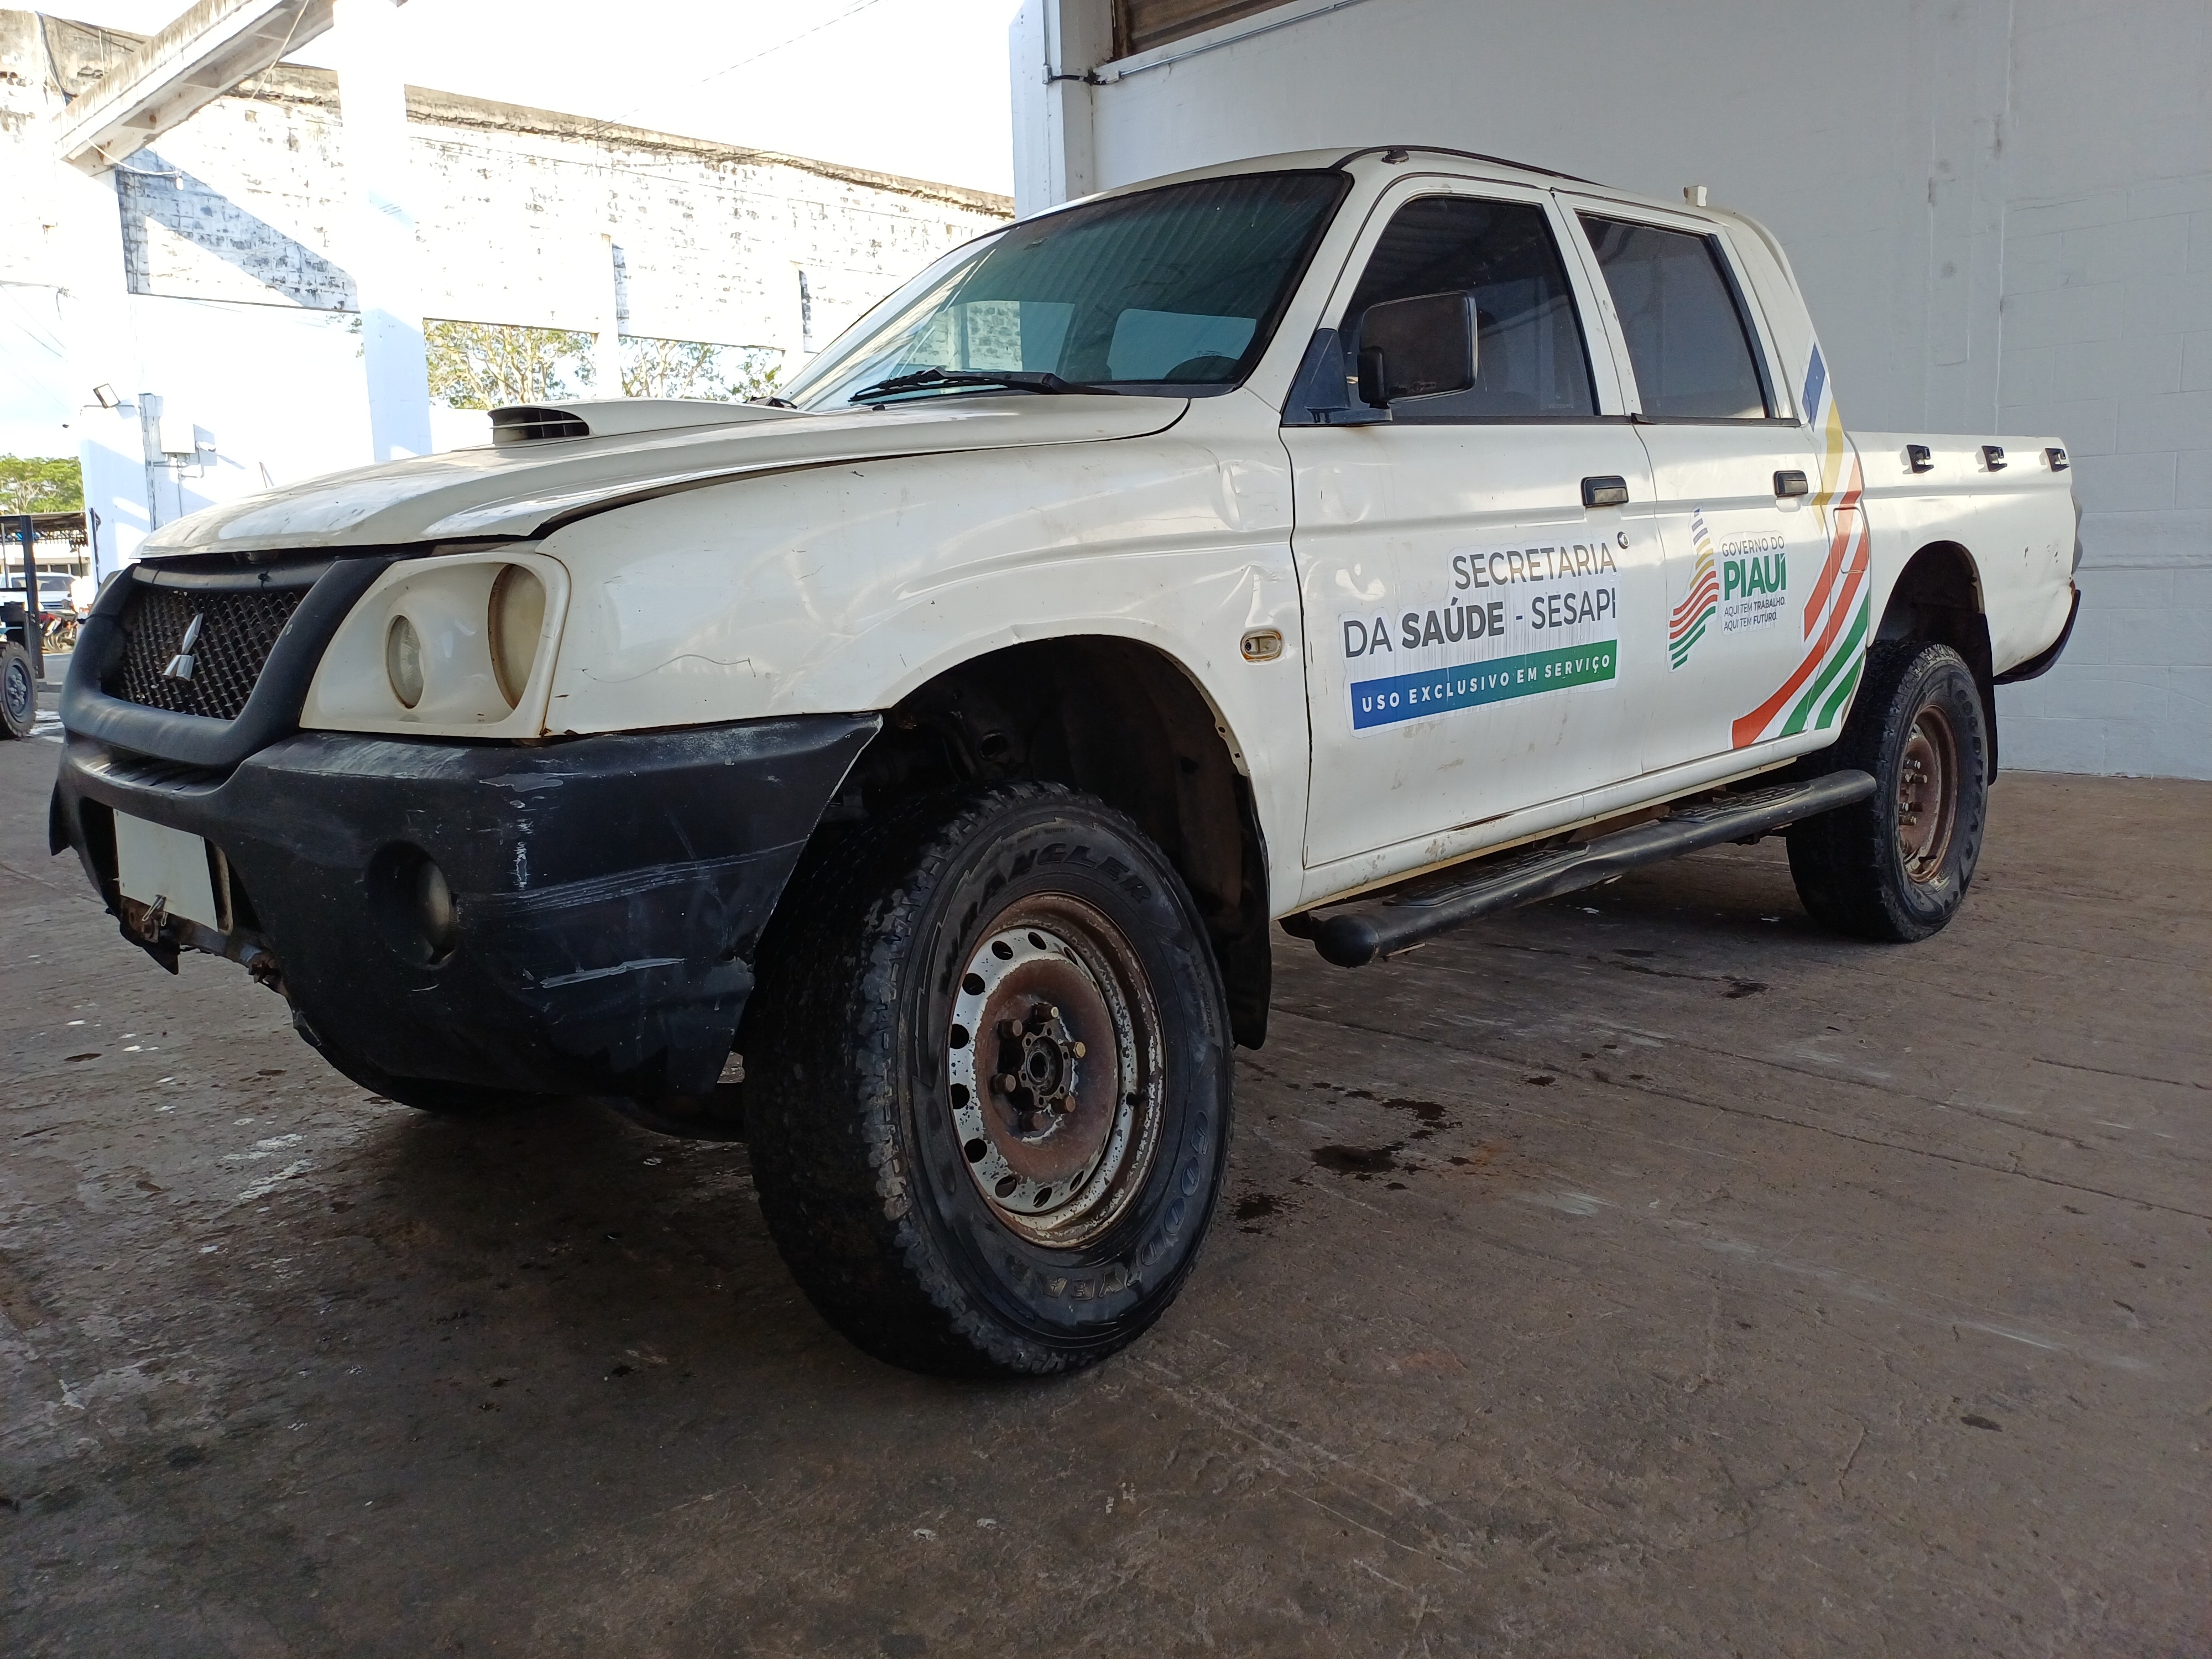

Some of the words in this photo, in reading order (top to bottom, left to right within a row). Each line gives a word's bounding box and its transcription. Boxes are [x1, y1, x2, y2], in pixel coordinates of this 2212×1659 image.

[1453, 543, 1617, 589] SECRETARIA
[1721, 538, 1768, 557] GOVERNO
[1770, 536, 1785, 550] DO
[1723, 553, 1786, 601] PIAUÍ
[1344, 617, 1392, 658] DA
[1401, 597, 1504, 649] SAÚDE
[1531, 587, 1616, 629] SESAPI
[1724, 605, 1739, 617] AQUI
[1740, 602, 1752, 614] TEM
[1754, 596, 1786, 611] TRABALHO.
[1724, 619, 1739, 632] AQUI
[1740, 616, 1752, 628] TEM
[1753, 612, 1778, 625] FUTURO.
[1362, 692, 1400, 712] USO
[1409, 672, 1509, 704] EXCLUSIVO
[1517, 667, 1537, 684] EM
[1545, 654, 1610, 678] SERVIÇO
[938, 842, 1152, 995] WRANGLER
[1004, 1110, 1209, 1301] GOODYEAR
